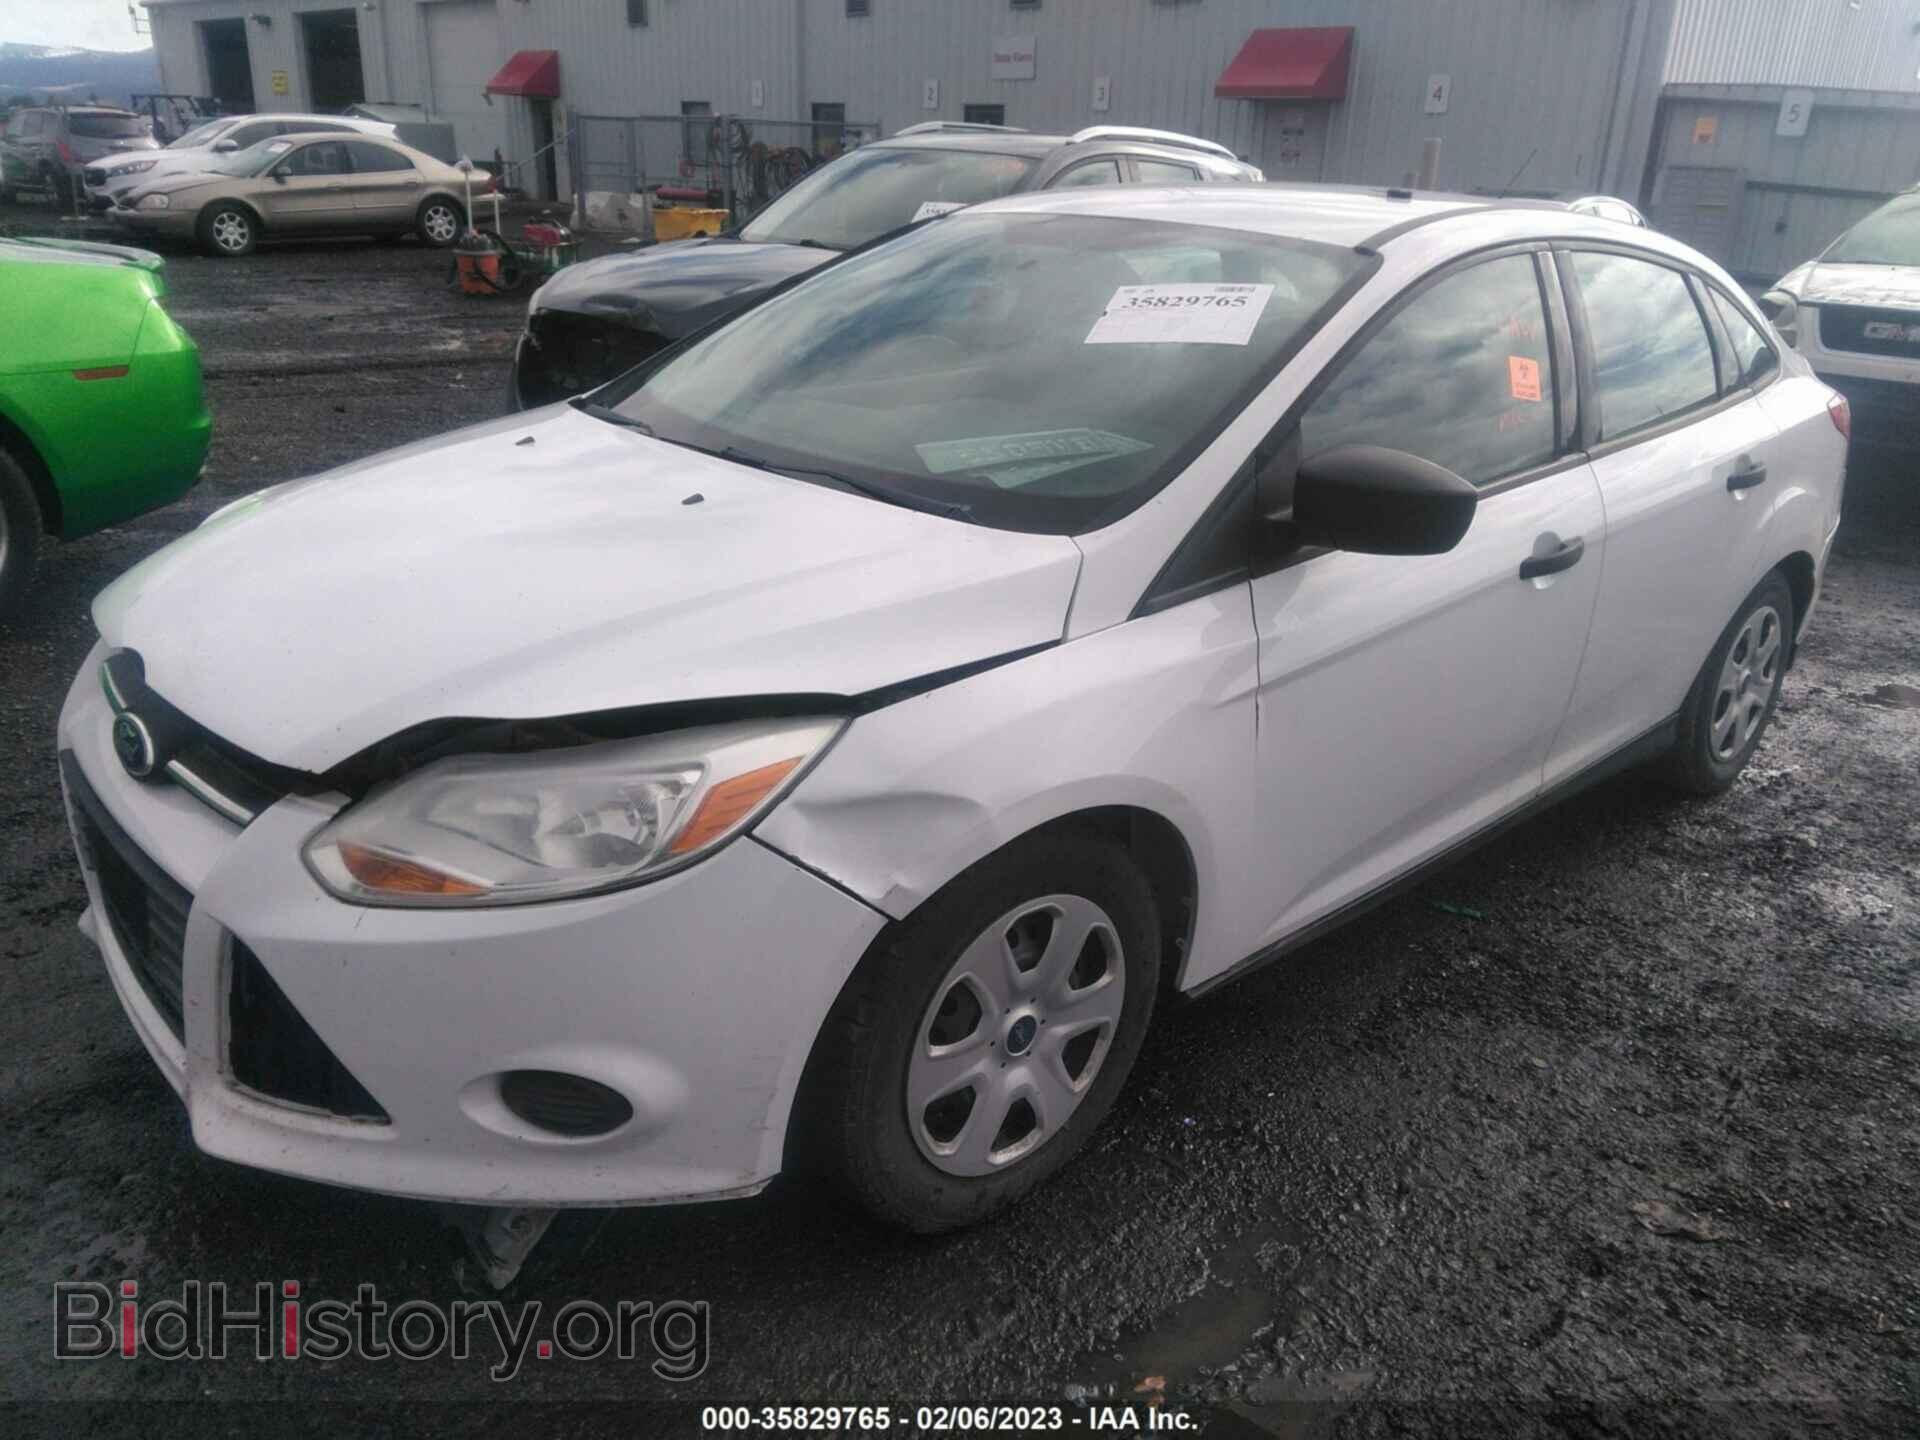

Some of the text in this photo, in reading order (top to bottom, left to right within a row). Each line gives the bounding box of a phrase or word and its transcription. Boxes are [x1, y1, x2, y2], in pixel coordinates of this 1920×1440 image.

[1431, 84, 1443, 103] 4
[1787, 103, 1801, 123] 5
[1121, 296, 1249, 309] 35829765
